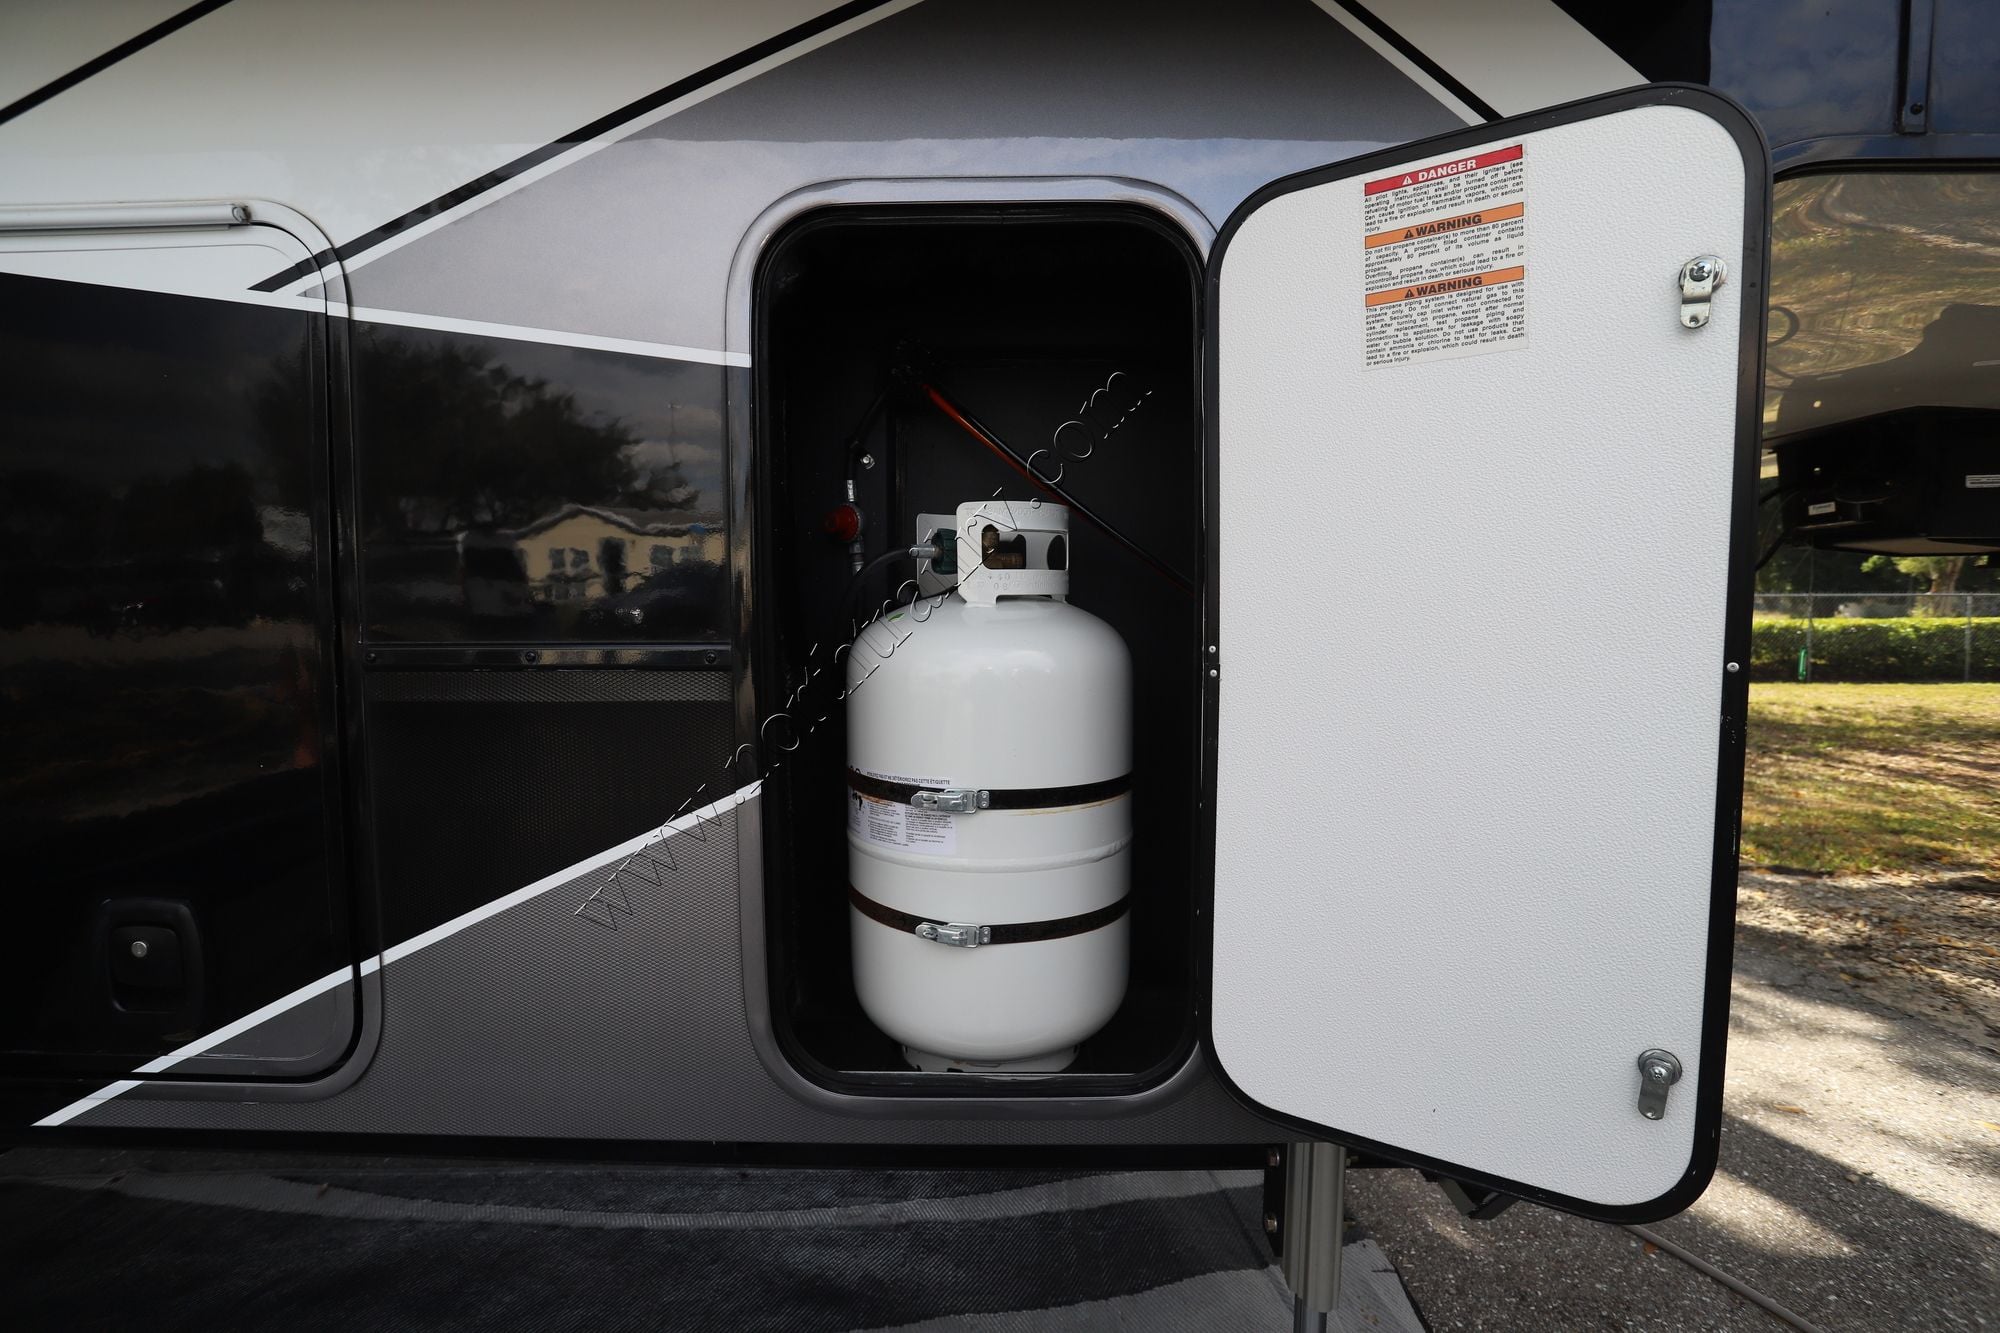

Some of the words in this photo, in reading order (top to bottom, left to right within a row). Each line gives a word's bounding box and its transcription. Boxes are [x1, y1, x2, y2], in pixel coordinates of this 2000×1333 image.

[1418, 159, 1476, 181] DANGER
[1364, 199, 1389, 209] operating
[1394, 189, 1429, 201] instructions)
[1465, 176, 1485, 185] turned
[1503, 167, 1523, 176] before
[1375, 193, 1387, 201] pilot
[1482, 165, 1505, 175] igniters
[1364, 206, 1388, 214] refueling
[1463, 182, 1488, 192] propane
[1397, 204, 1418, 213] ignition
[1431, 194, 1461, 205] flammable
[1490, 184, 1508, 192] which
[1406, 207, 1434, 217] explosion
[1448, 200, 1464, 208] result
[1500, 187, 1523, 196] serious
[1392, 241, 1415, 250] propane
[1416, 233, 1450, 244] container(s)
[1500, 218, 1523, 228] percent
[1416, 214, 1481, 236] WARNING
[1364, 256, 1402, 268] approximately
[1418, 248, 1439, 257] percent
[1467, 238, 1489, 246] volume
[1506, 231, 1524, 239] liquid
[1413, 242, 1437, 252] properly
[1463, 231, 1491, 241] container
[1497, 225, 1523, 234] contains
[1399, 264, 1422, 273] propane
[1430, 255, 1464, 266] container(s)
[1365, 274, 1398, 285] uncontrolled
[1400, 270, 1423, 279] propane
[1365, 282, 1391, 291] explosion
[1416, 275, 1482, 296] WARNING
[1365, 311, 1387, 320] propane
[1433, 298, 1457, 307] connect
[1461, 294, 1481, 302] natural
[1379, 303, 1402, 311] propane
[1455, 288, 1482, 297] designed
[1389, 312, 1413, 321] Securely
[1480, 295, 1511, 305] connected
[1461, 307, 1480, 315] except
[1502, 300, 1524, 308] normal
[1454, 314, 1478, 323] propane
[1481, 322, 1508, 331] products
[1365, 334, 1398, 342] connections
[1412, 326, 1443, 335] appliances
